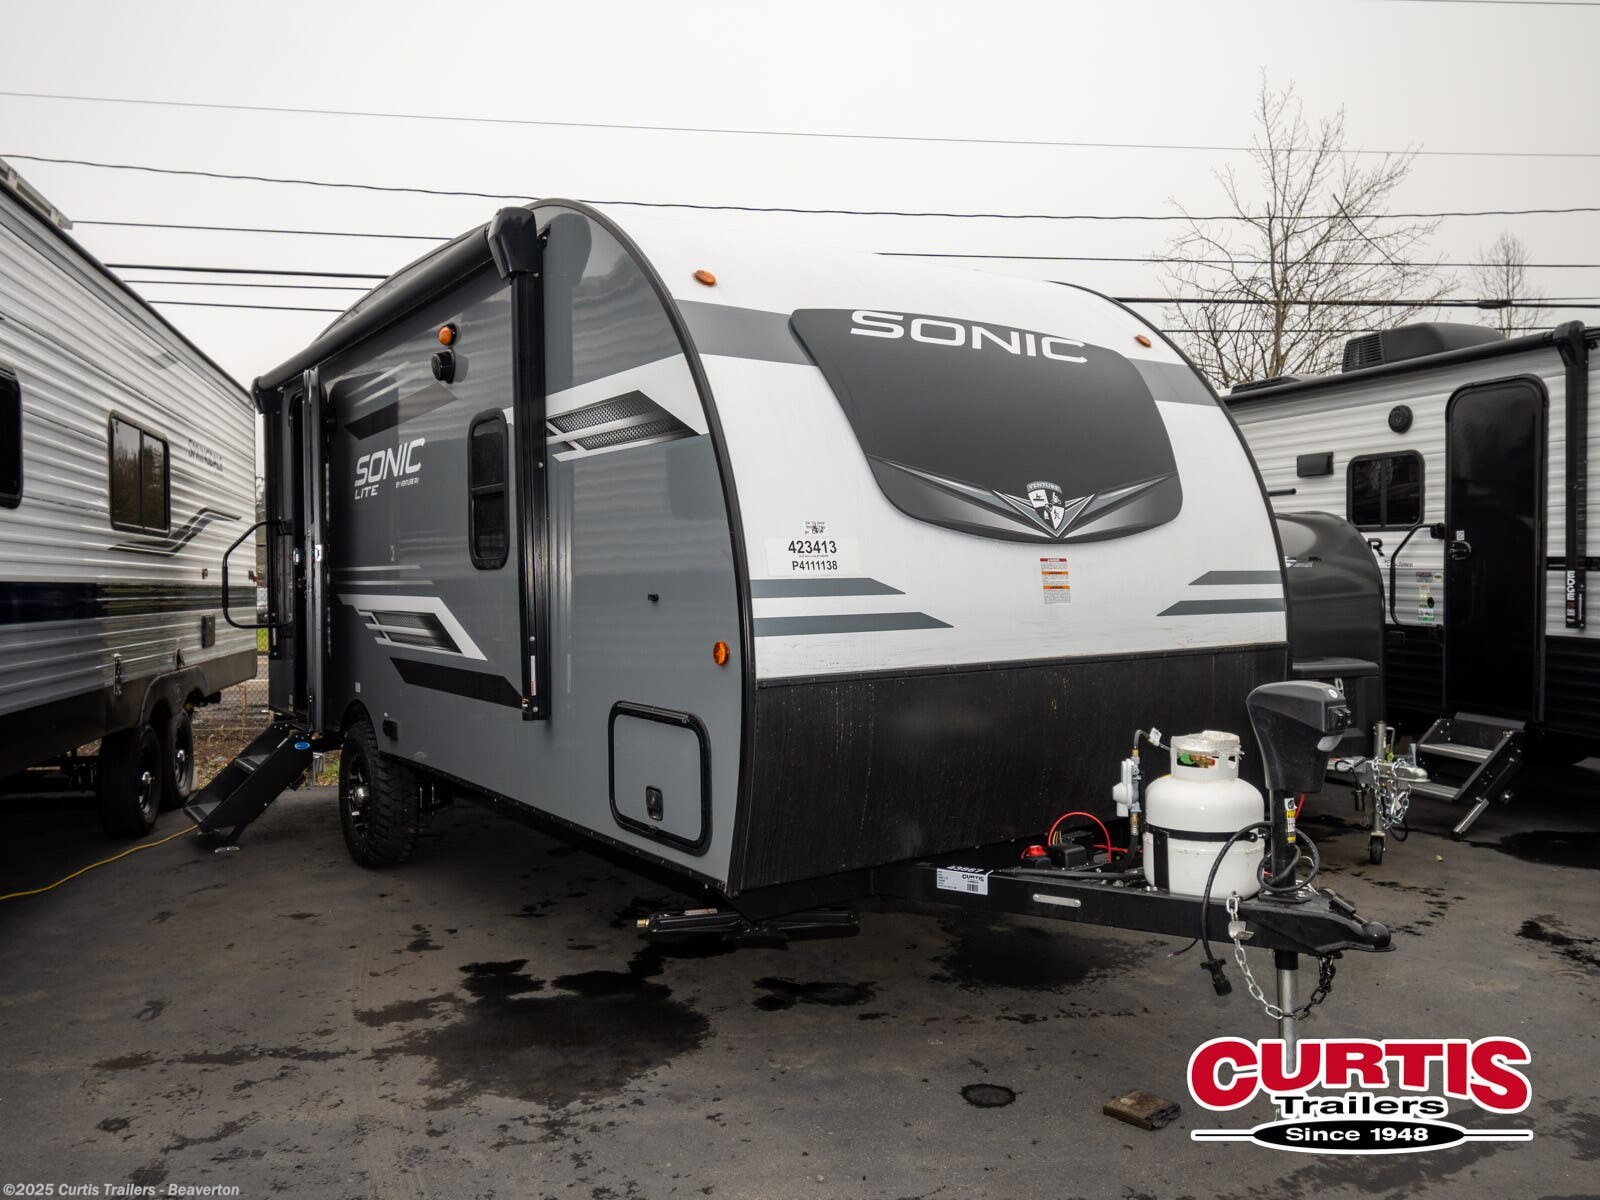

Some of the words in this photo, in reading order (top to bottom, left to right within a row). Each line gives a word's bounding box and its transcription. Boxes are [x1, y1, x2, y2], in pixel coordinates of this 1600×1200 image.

[850, 309, 1088, 364] SONIC
[354, 437, 426, 488] SONIC
[354, 484, 380, 500] LITE
[788, 540, 837, 554] 423413
[792, 560, 838, 571] P4111138
[962, 873, 985, 882] CURTIS
